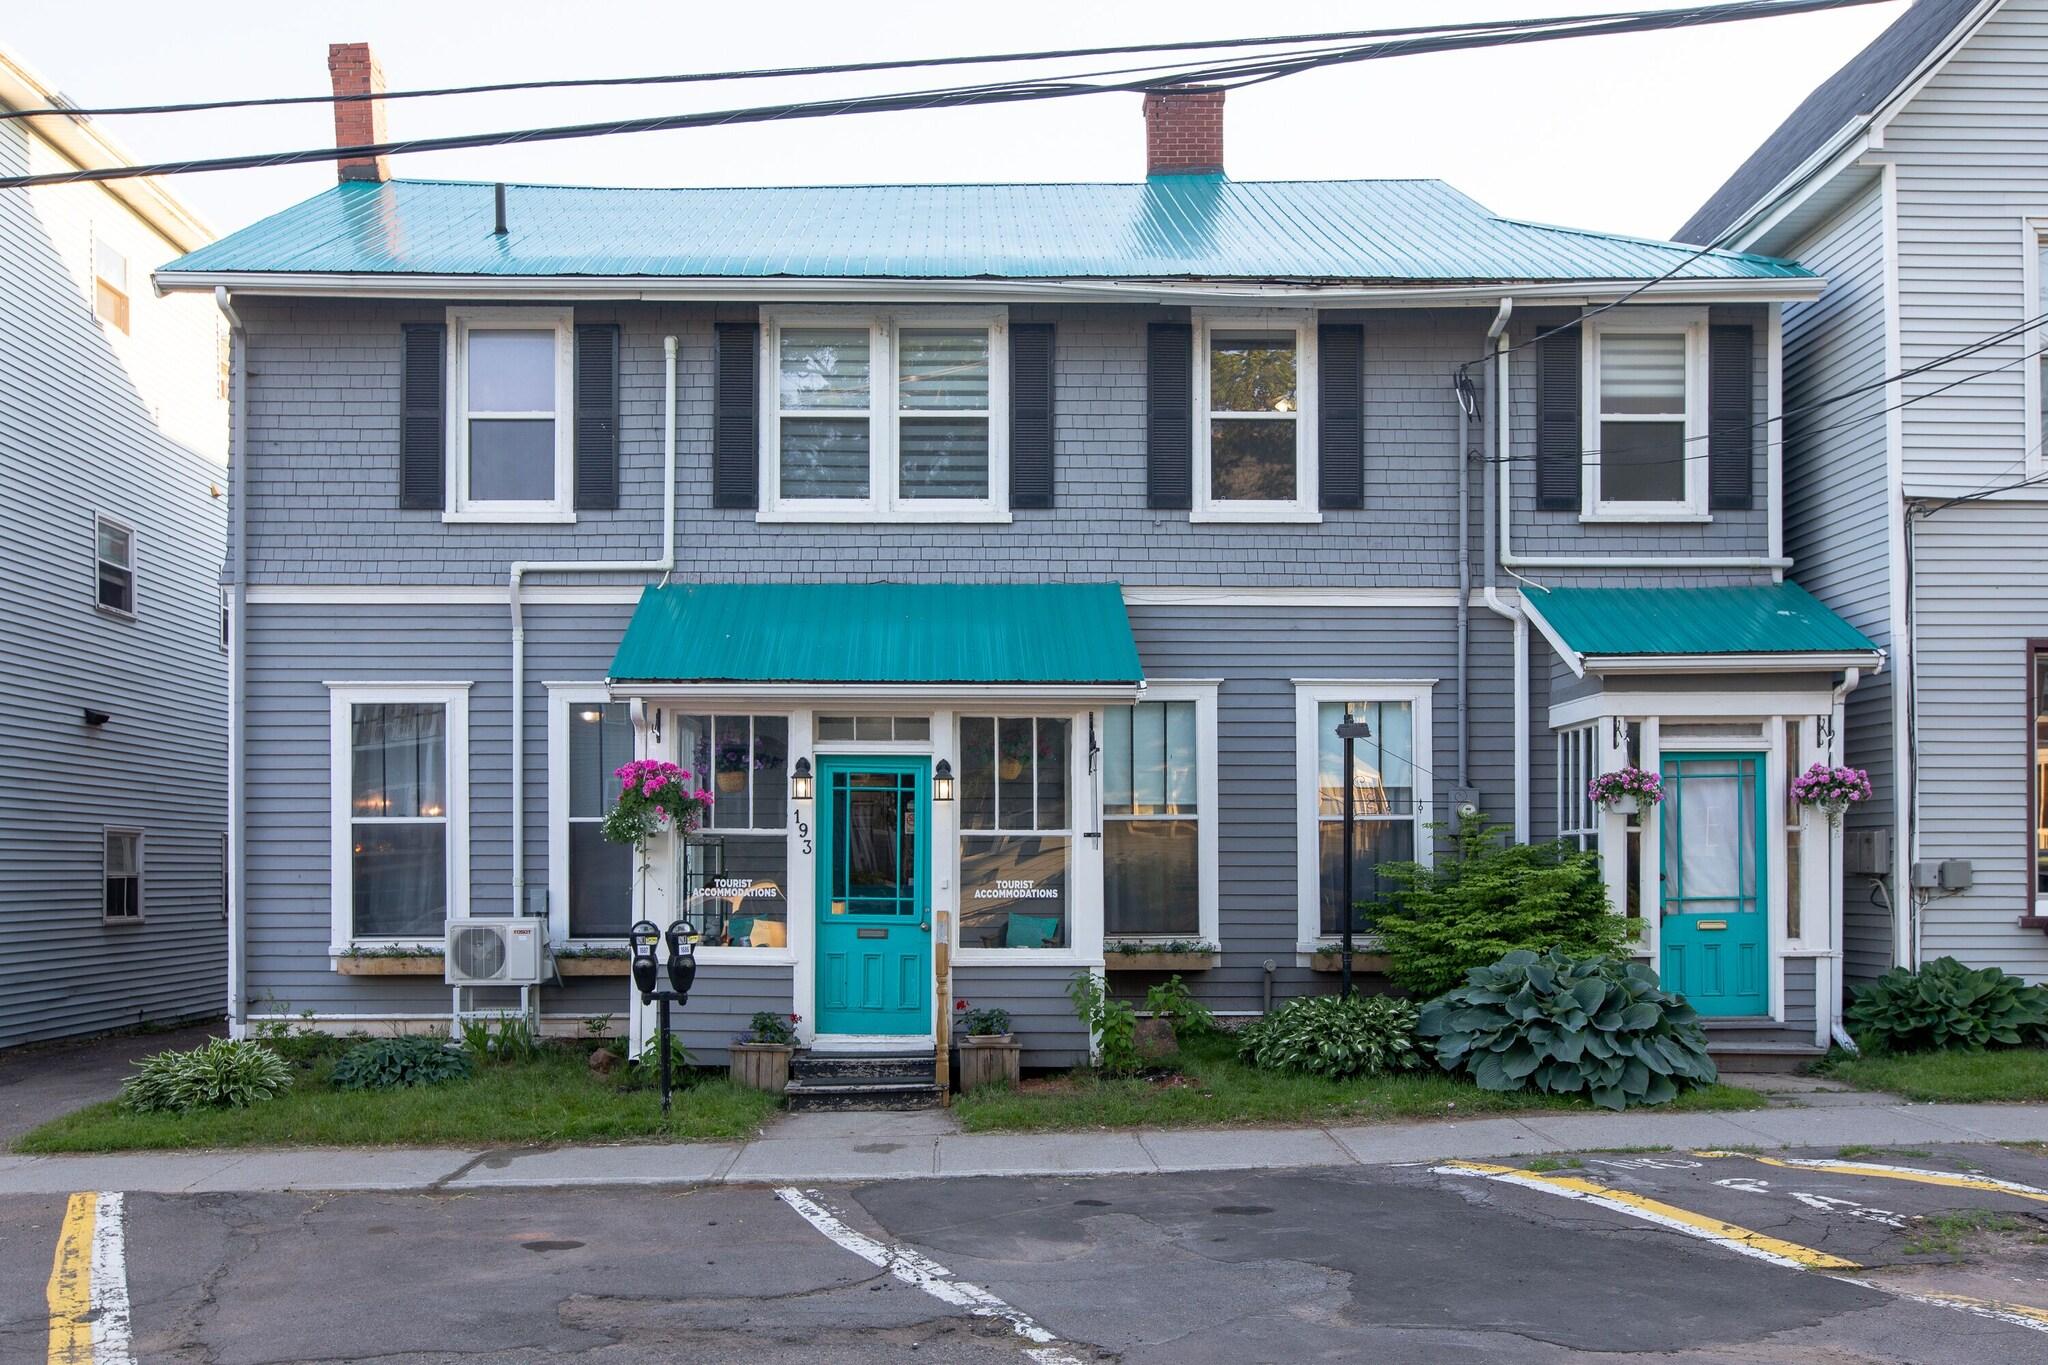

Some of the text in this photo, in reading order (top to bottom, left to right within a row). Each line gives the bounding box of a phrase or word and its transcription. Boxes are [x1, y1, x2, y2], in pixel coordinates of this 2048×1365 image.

[793, 808, 812, 855] 193
[714, 879, 752, 888] TOURIST
[996, 880, 1034, 889] TOURIST
[692, 887, 777, 897] ACCOMMODATIONS
[974, 889, 1058, 898] ACCOMMODATIONS
